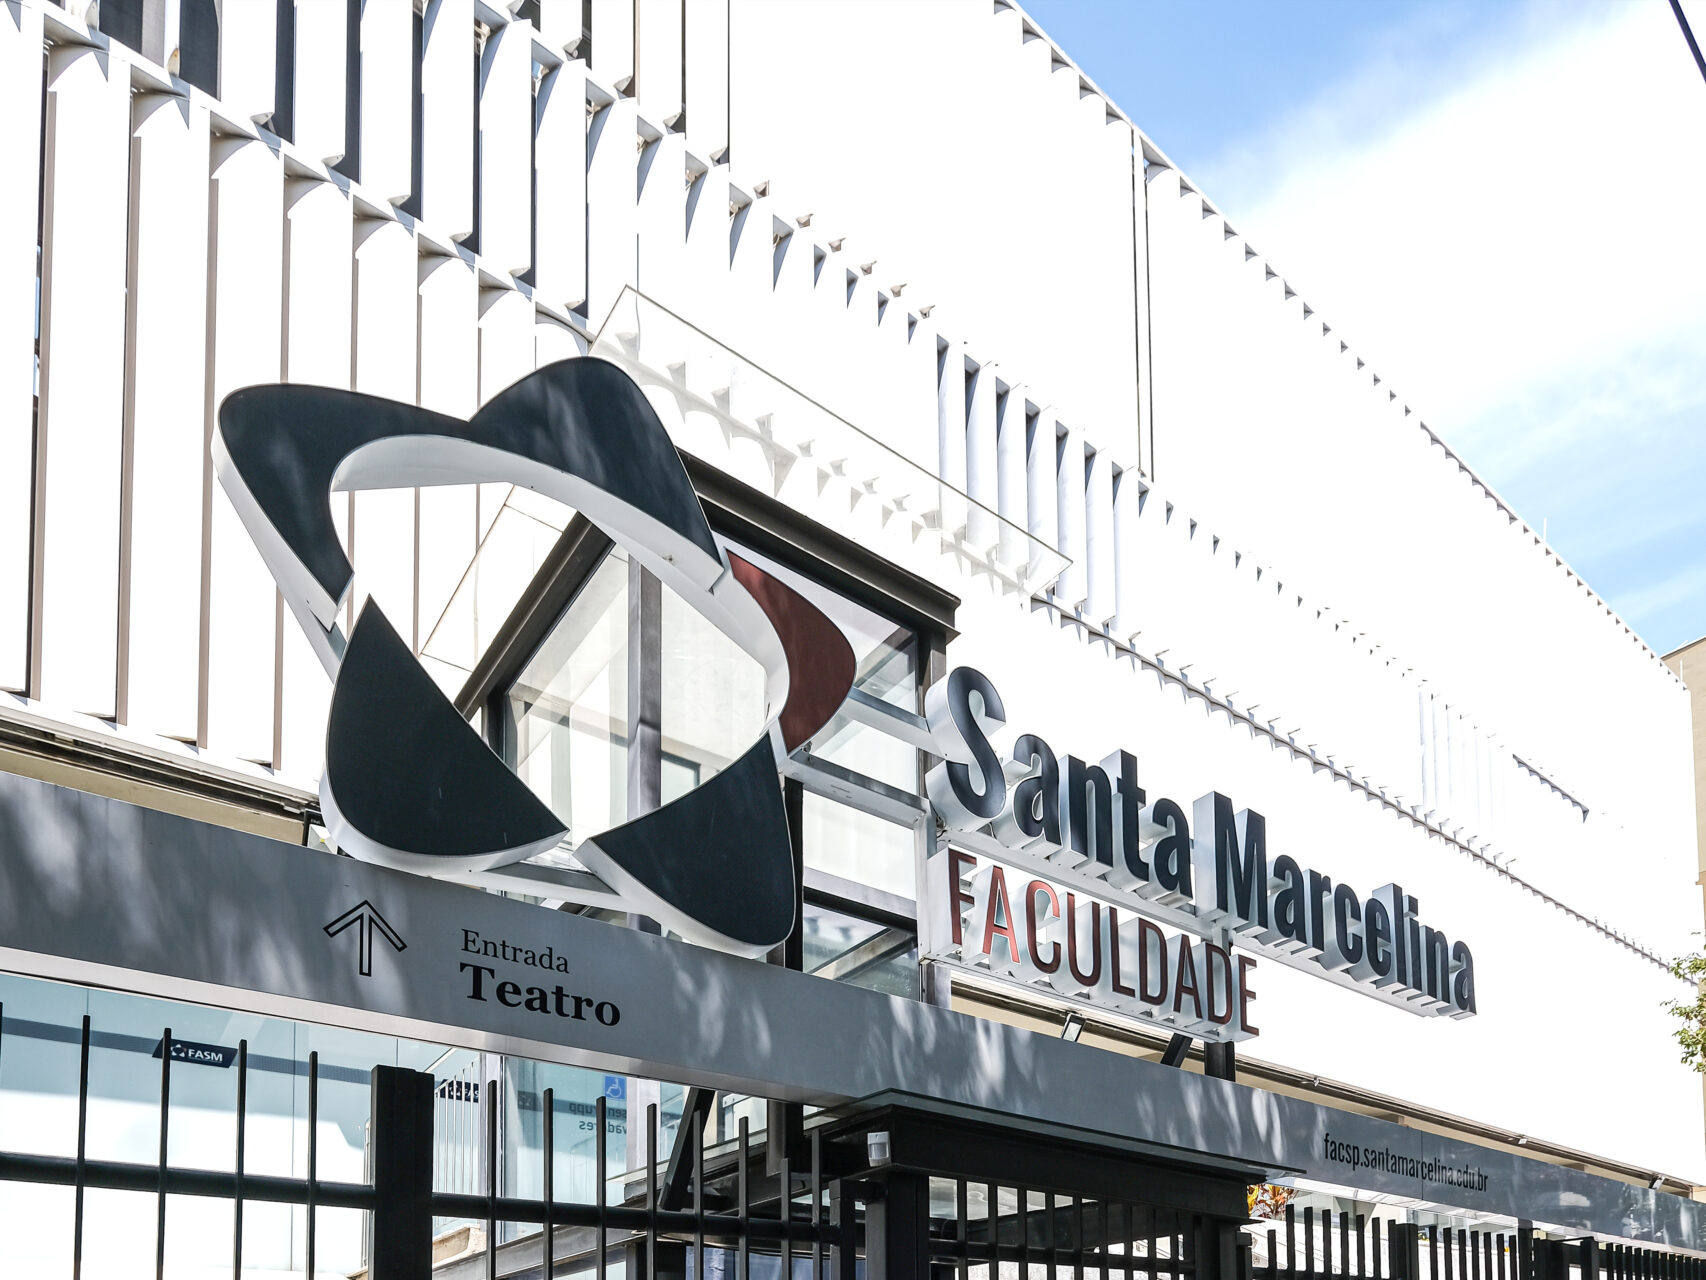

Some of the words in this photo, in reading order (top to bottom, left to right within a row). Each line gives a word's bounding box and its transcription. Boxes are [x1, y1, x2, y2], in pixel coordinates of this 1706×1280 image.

[945, 666, 1195, 901] Santa
[1213, 791, 1476, 1016] Marcelina
[461, 928, 570, 974] Entrada
[949, 848, 1260, 1037] FACULDADE
[459, 962, 621, 1027] Teatro
[188, 1048, 223, 1062] FASM
[1324, 1132, 1488, 1193] facsp.santamarcelina.edu.br
